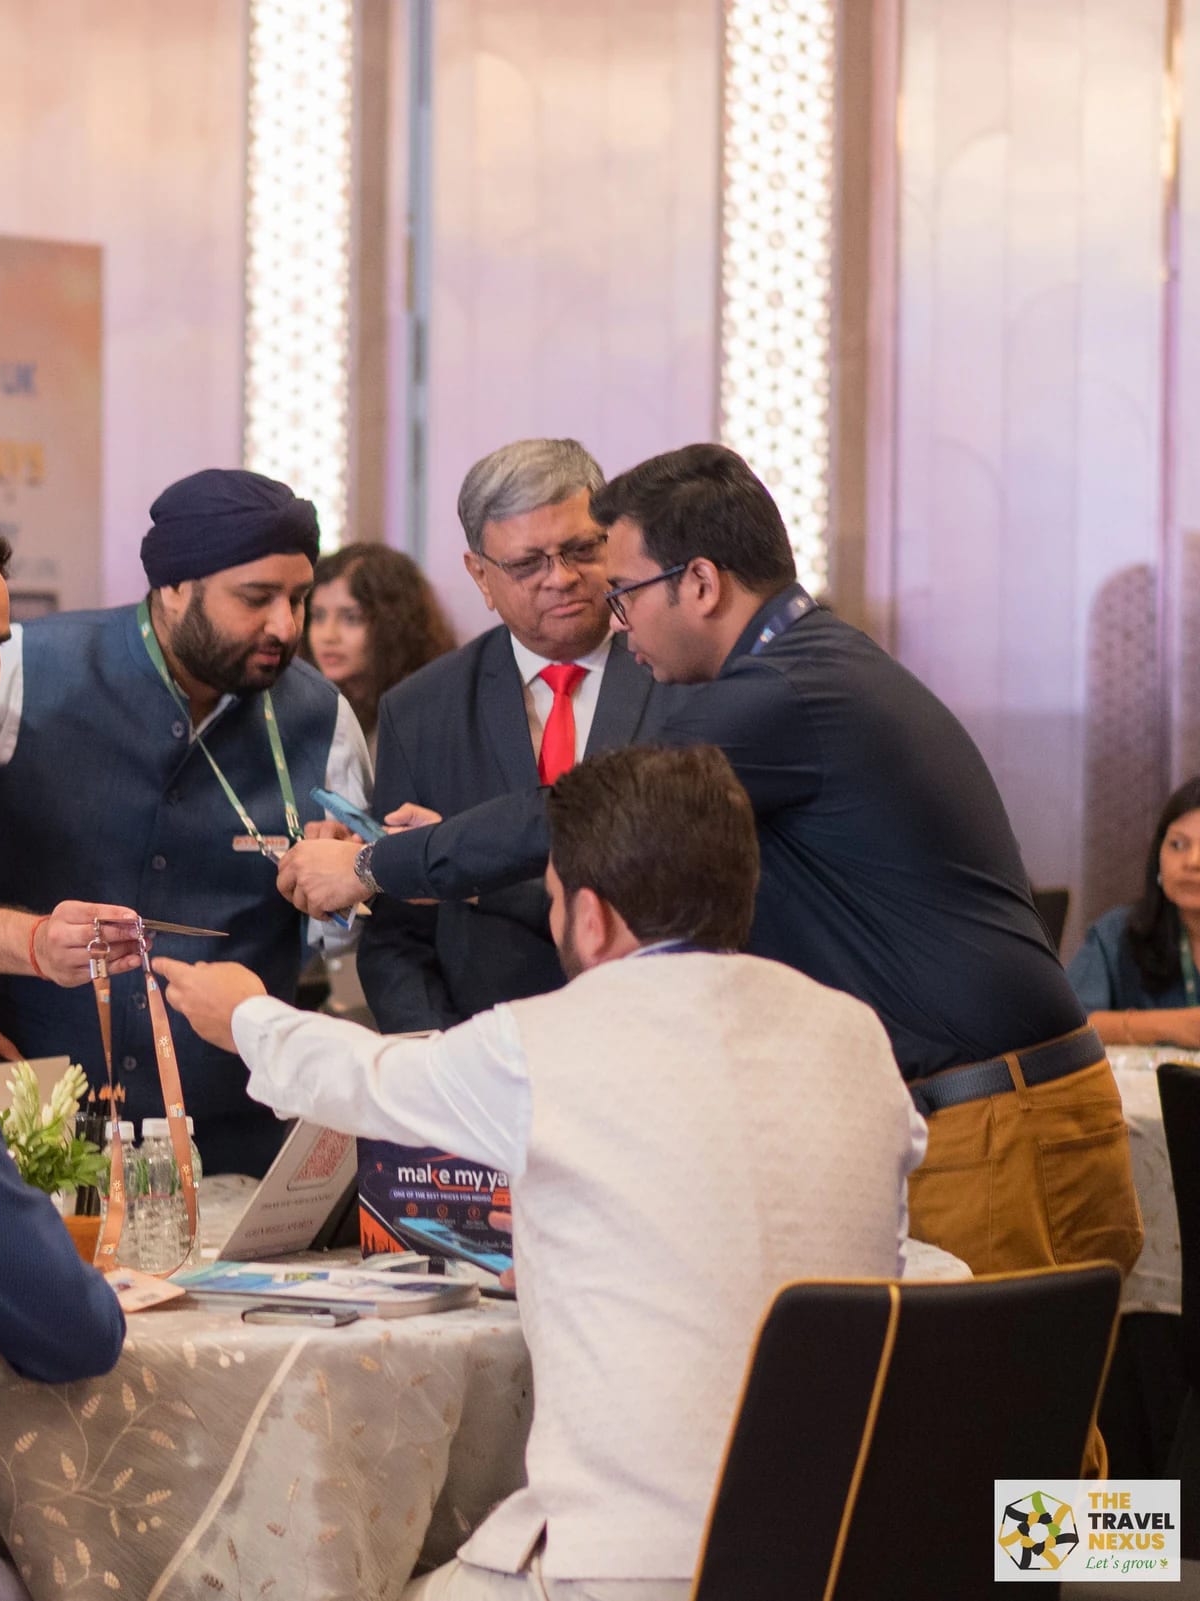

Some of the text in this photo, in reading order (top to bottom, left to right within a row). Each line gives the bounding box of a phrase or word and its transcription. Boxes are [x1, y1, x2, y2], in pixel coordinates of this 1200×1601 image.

[0, 364, 38, 396] UK
[398, 1163, 450, 1185] make
[455, 1170, 483, 1192] my
